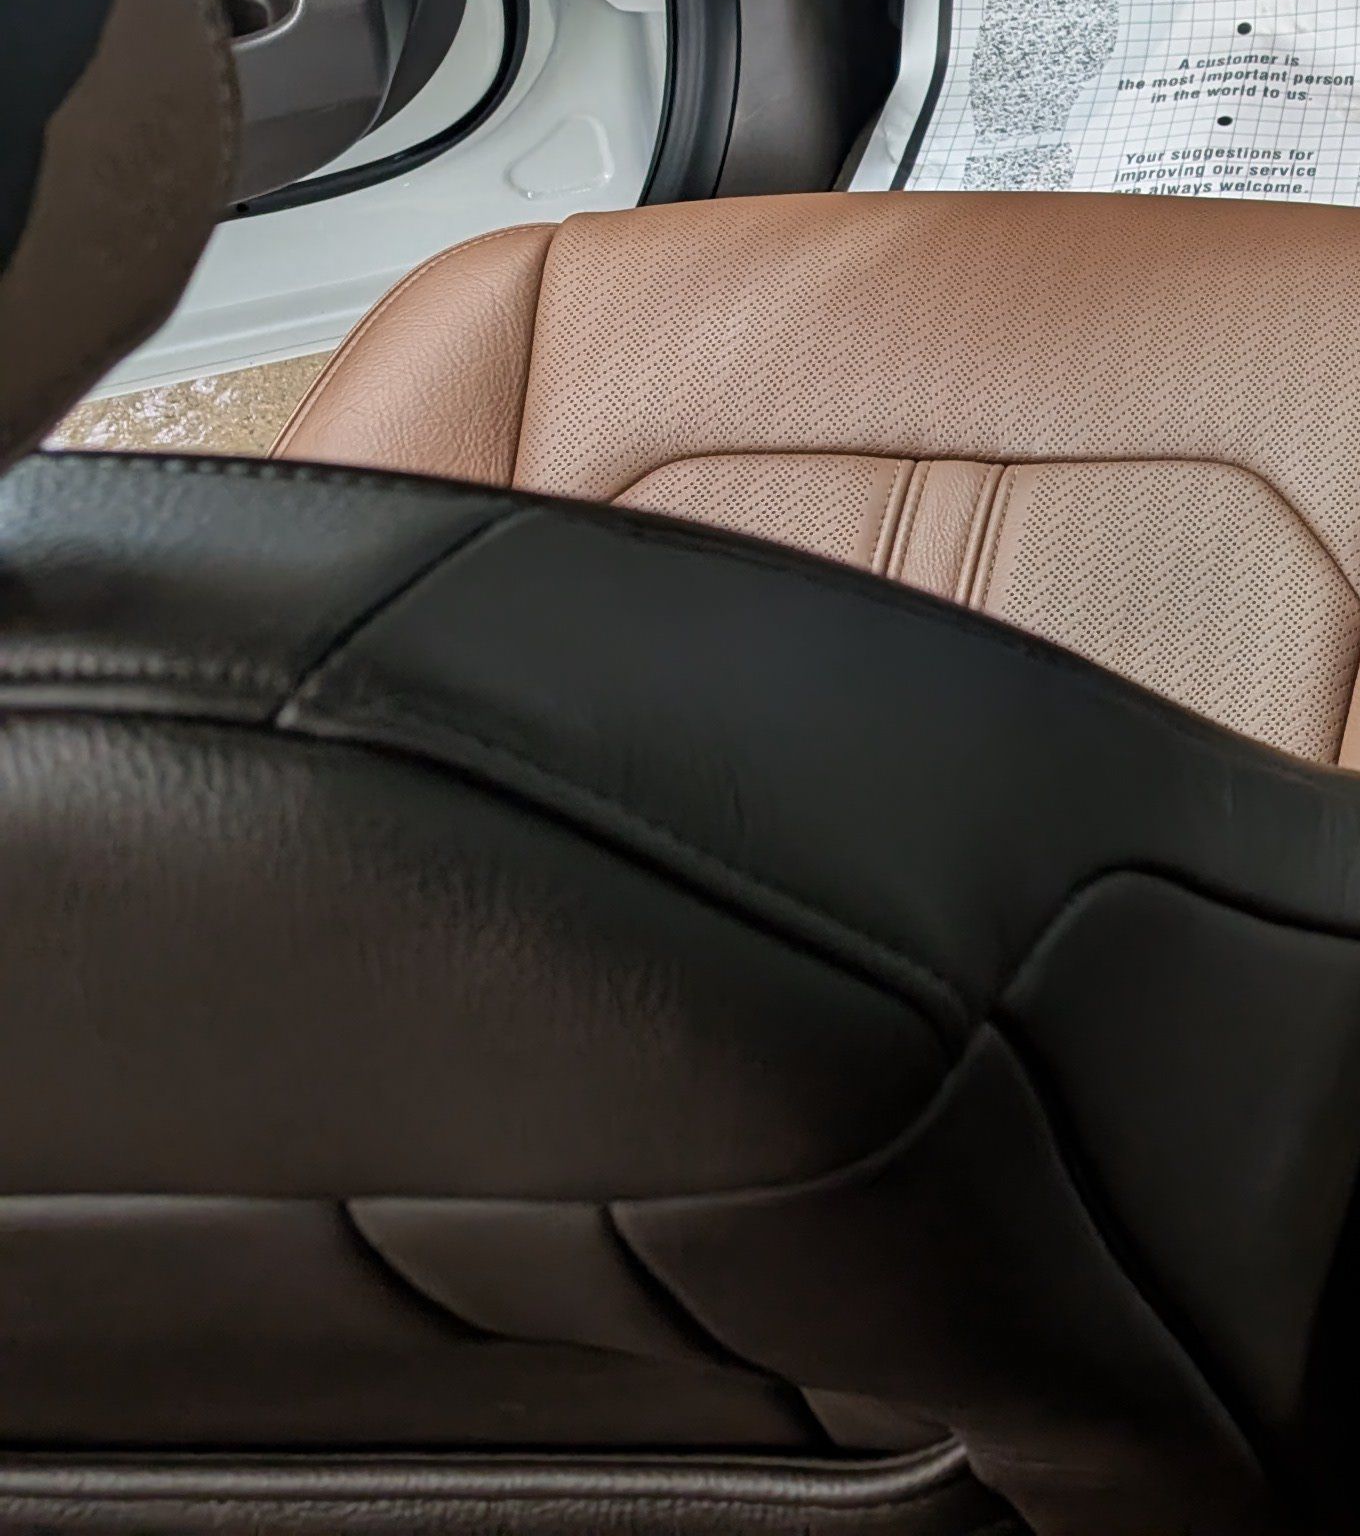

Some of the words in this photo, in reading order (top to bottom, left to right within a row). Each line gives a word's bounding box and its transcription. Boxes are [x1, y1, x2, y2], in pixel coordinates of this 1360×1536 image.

[1178, 58, 1190, 70] A
[1197, 54, 1279, 69] customer
[1285, 55, 1299, 66] is
[1117, 79, 1145, 91] the
[1152, 74, 1194, 88] most
[1201, 69, 1288, 84] important
[1293, 72, 1355, 86] person
[1150, 92, 1166, 104] in
[1173, 90, 1199, 101] the
[1207, 85, 1256, 97] world
[1263, 86, 1280, 99] to
[1287, 89, 1312, 102] us.
[1125, 151, 1165, 165] Your
[1171, 147, 1282, 162] suggestions
[1289, 149, 1315, 161] for
[1114, 164, 1205, 183] improving
[1212, 165, 1242, 177] our
[1249, 164, 1317, 178] service
[1149, 181, 1212, 196] always
[1220, 180, 1309, 194] welcome.
